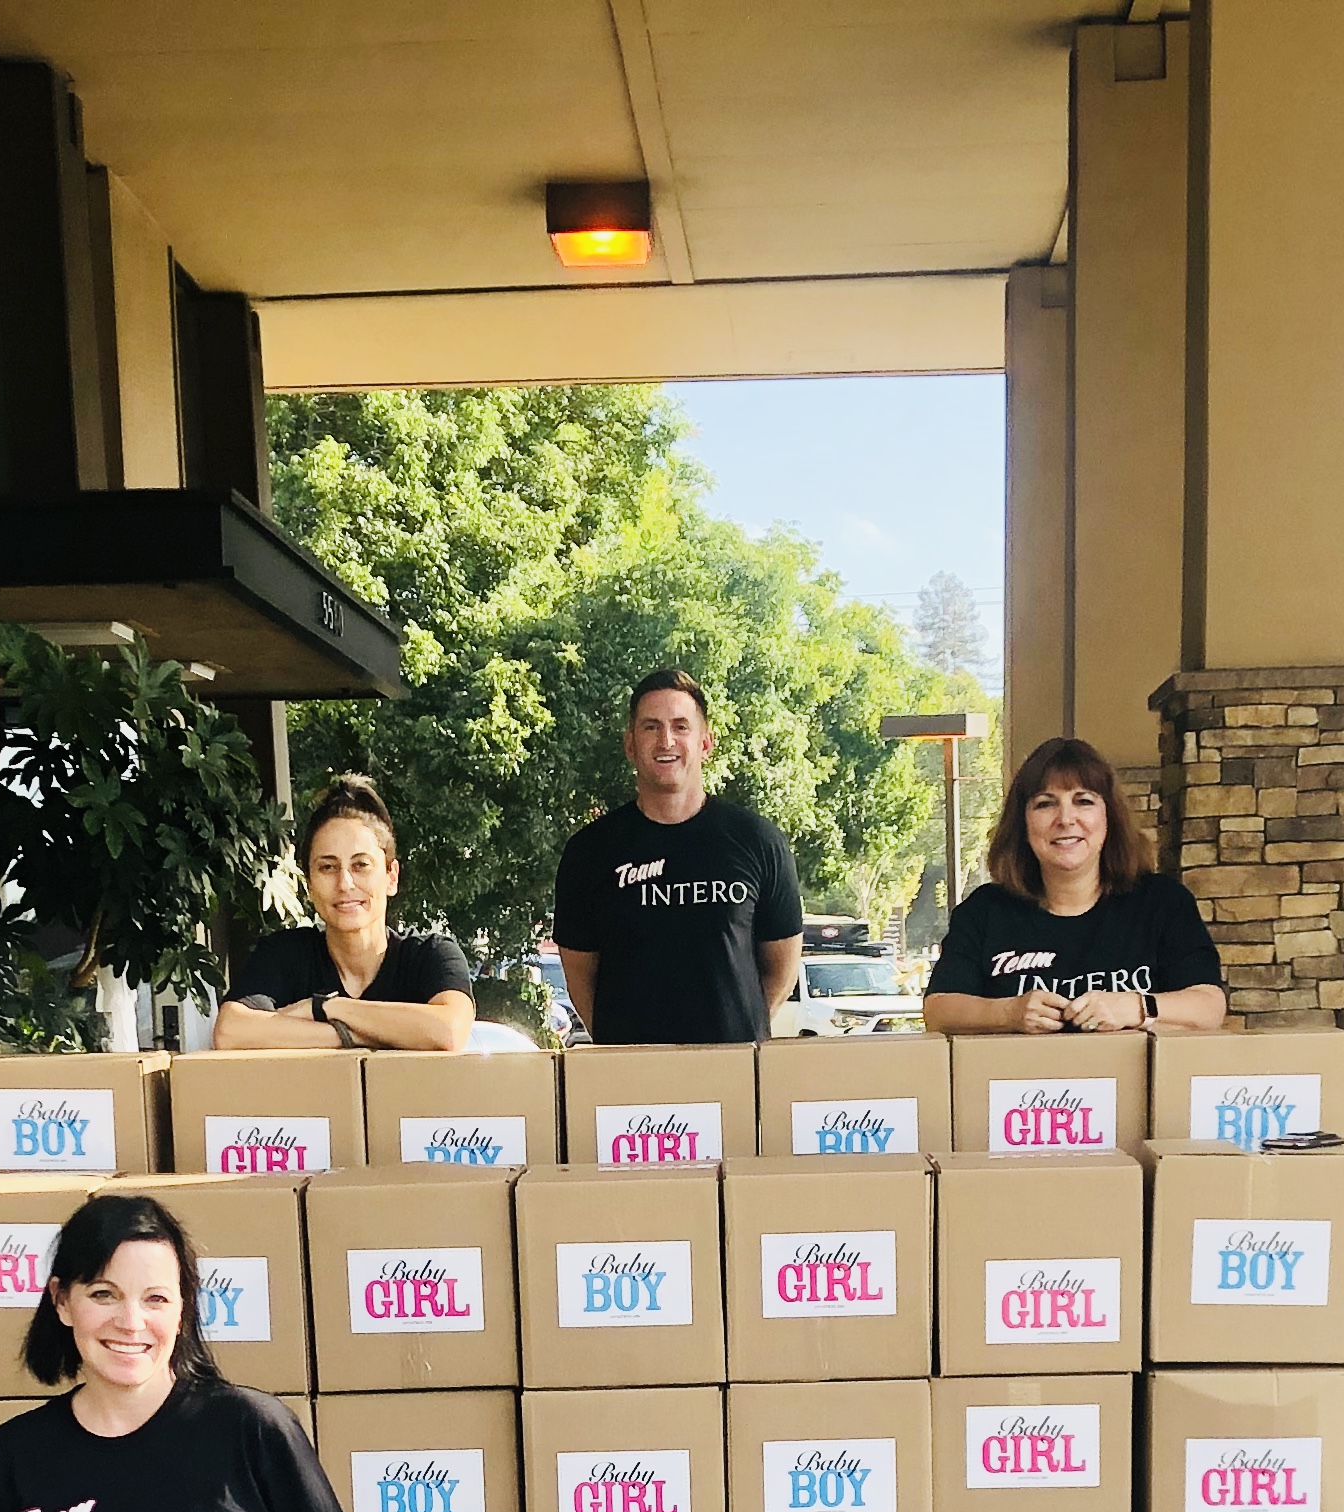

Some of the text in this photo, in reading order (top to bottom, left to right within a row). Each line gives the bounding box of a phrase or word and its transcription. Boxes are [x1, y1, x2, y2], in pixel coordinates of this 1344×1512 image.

[615, 858, 666, 889] Team
[641, 880, 748, 906] INTERO
[991, 950, 1057, 977] Team
[1017, 965, 1152, 999] INTERO
[1019, 1089, 1083, 1115] Baby
[1221, 1086, 1285, 1112] Baby
[18, 1101, 79, 1127] Baby
[627, 1114, 688, 1140] Baby
[822, 1110, 884, 1135] Baby
[1004, 1107, 1102, 1145] GIRL
[1215, 1104, 1296, 1141] BOY
[13, 1119, 88, 1156] BOY
[235, 1127, 297, 1153] Baby
[431, 1128, 492, 1153] Baby
[816, 1127, 894, 1153] BOY
[793, 1243, 860, 1270] Baby
[1224, 1232, 1293, 1258] Baby
[380, 1260, 446, 1287] Baby
[589, 1253, 655, 1280] Baby
[1218, 1250, 1302, 1290] BOY
[583, 1272, 666, 1312] BOY
[778, 1262, 882, 1302] GIRL
[1017, 1270, 1084, 1297] Baby
[197, 1287, 244, 1327] OY
[365, 1279, 470, 1318] GIRL
[1002, 1289, 1106, 1328] GIRL
[997, 1416, 1064, 1443] Baby
[795, 1450, 860, 1475] Baby
[982, 1435, 1086, 1473] GIRL
[1217, 1450, 1285, 1476] Baby
[383, 1461, 448, 1486] Baby
[589, 1462, 654, 1488] Baby
[1202, 1468, 1306, 1506] GIRL
[789, 1467, 870, 1508] BOY
